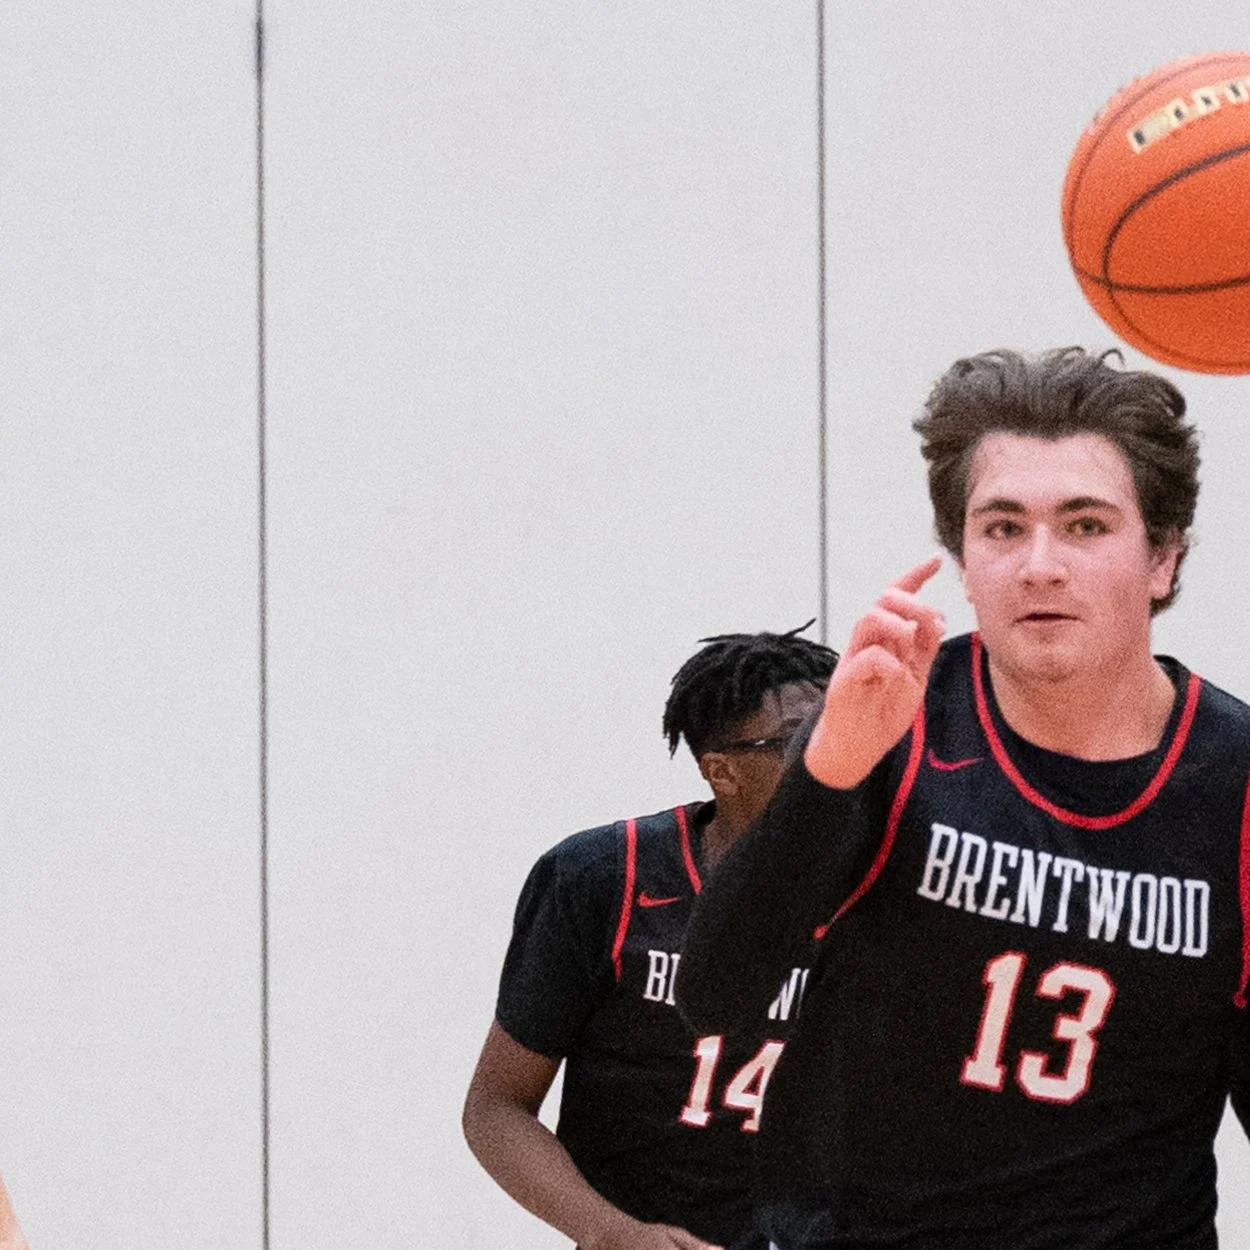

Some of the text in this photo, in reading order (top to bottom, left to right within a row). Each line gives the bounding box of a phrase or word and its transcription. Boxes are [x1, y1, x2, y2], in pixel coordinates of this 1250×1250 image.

[917, 822, 1211, 958] BRENTWOOD
[678, 1033, 786, 1133] 14
[959, 950, 1116, 1105] 13
